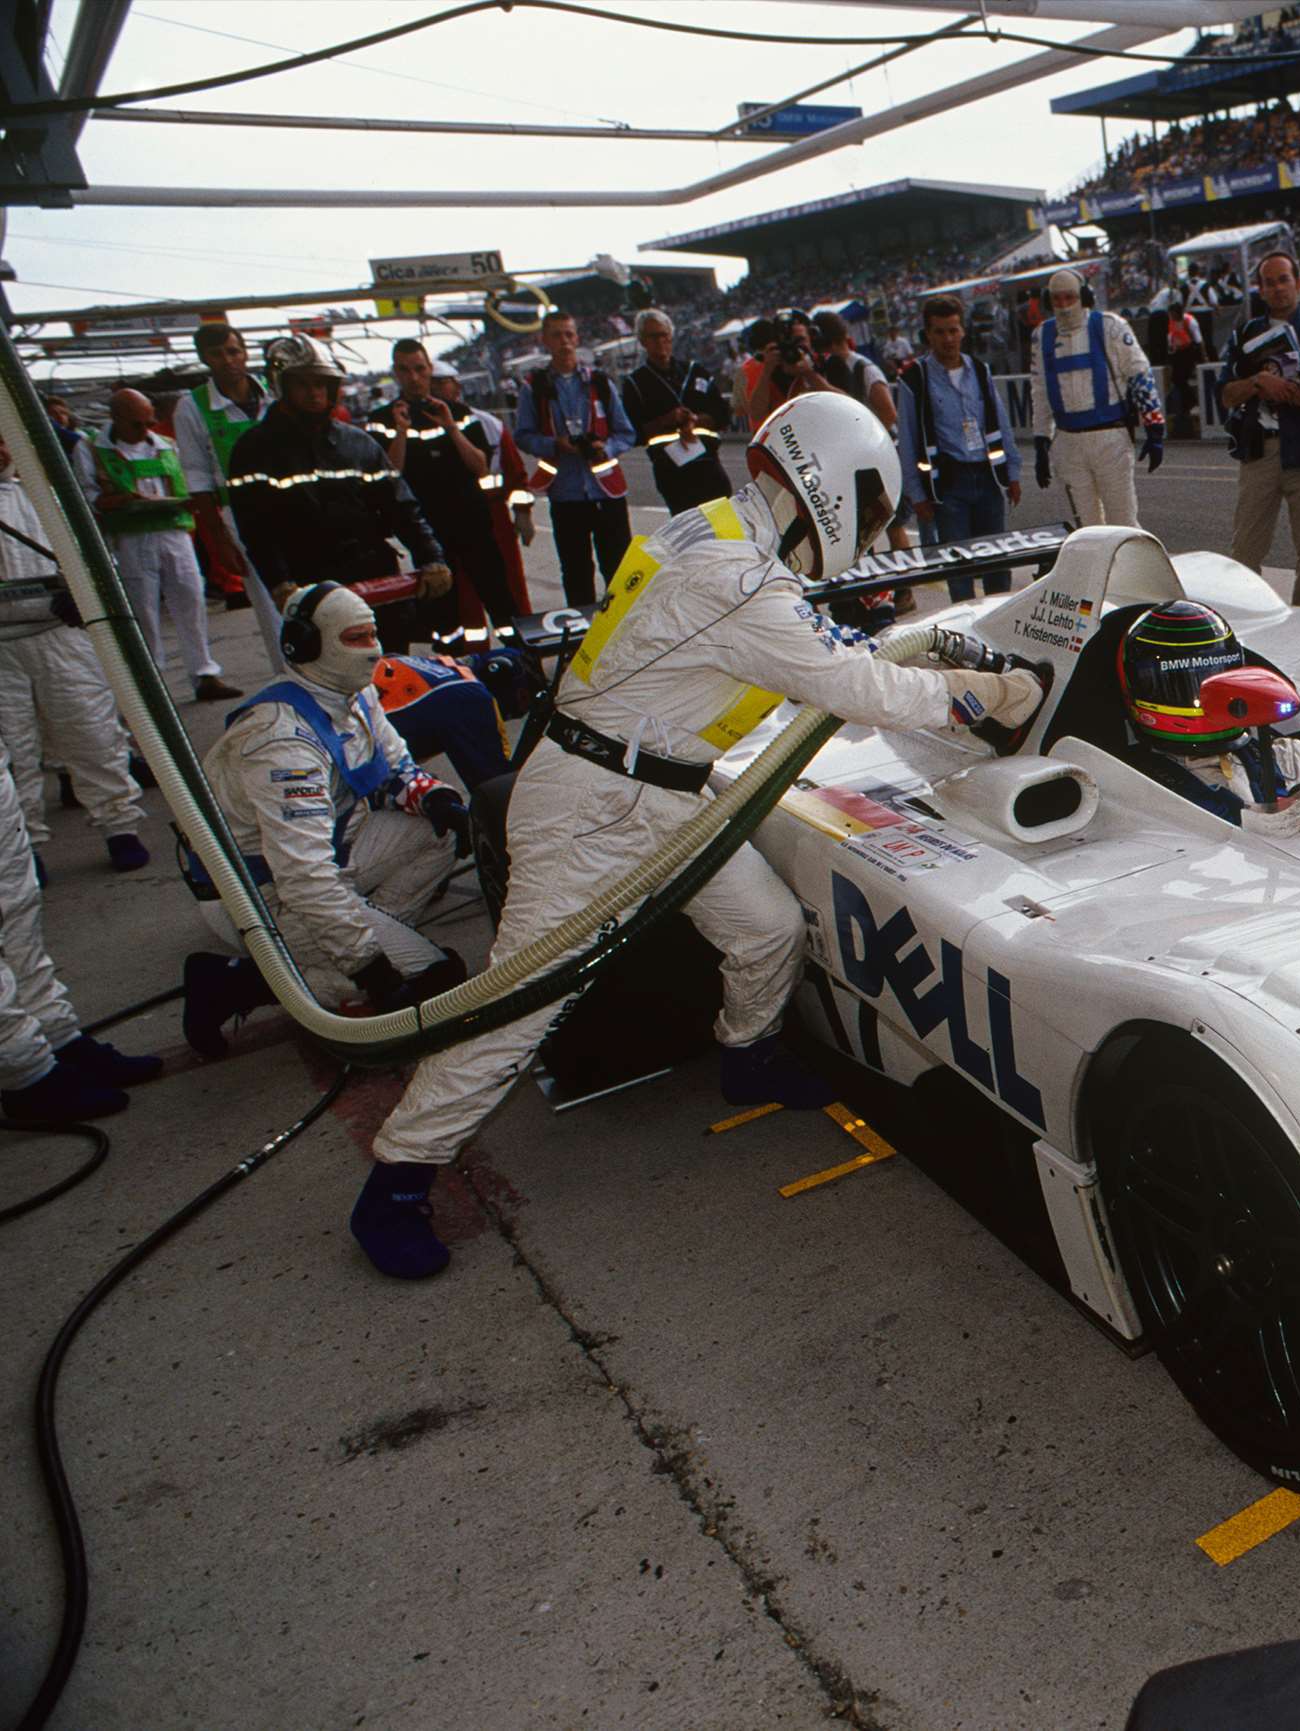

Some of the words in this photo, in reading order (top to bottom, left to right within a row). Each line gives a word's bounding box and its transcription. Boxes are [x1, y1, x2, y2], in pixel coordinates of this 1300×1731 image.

[470, 252, 501, 274] 50
[780, 424, 804, 461] BMW
[796, 462, 841, 545] Motorsport
[831, 547, 928, 584] MW
[1039, 590, 1048, 605] J.
[1049, 591, 1079, 612] Müller
[1031, 606, 1046, 623] J.J.
[1048, 610, 1074, 630] Lehto
[1014, 620, 1021, 634] T.
[1023, 623, 1069, 649] Kristensen
[1160, 658, 1190, 671] BMW
[1191, 652, 1240, 668] Motorsport
[831, 869, 1047, 1132] DELL
